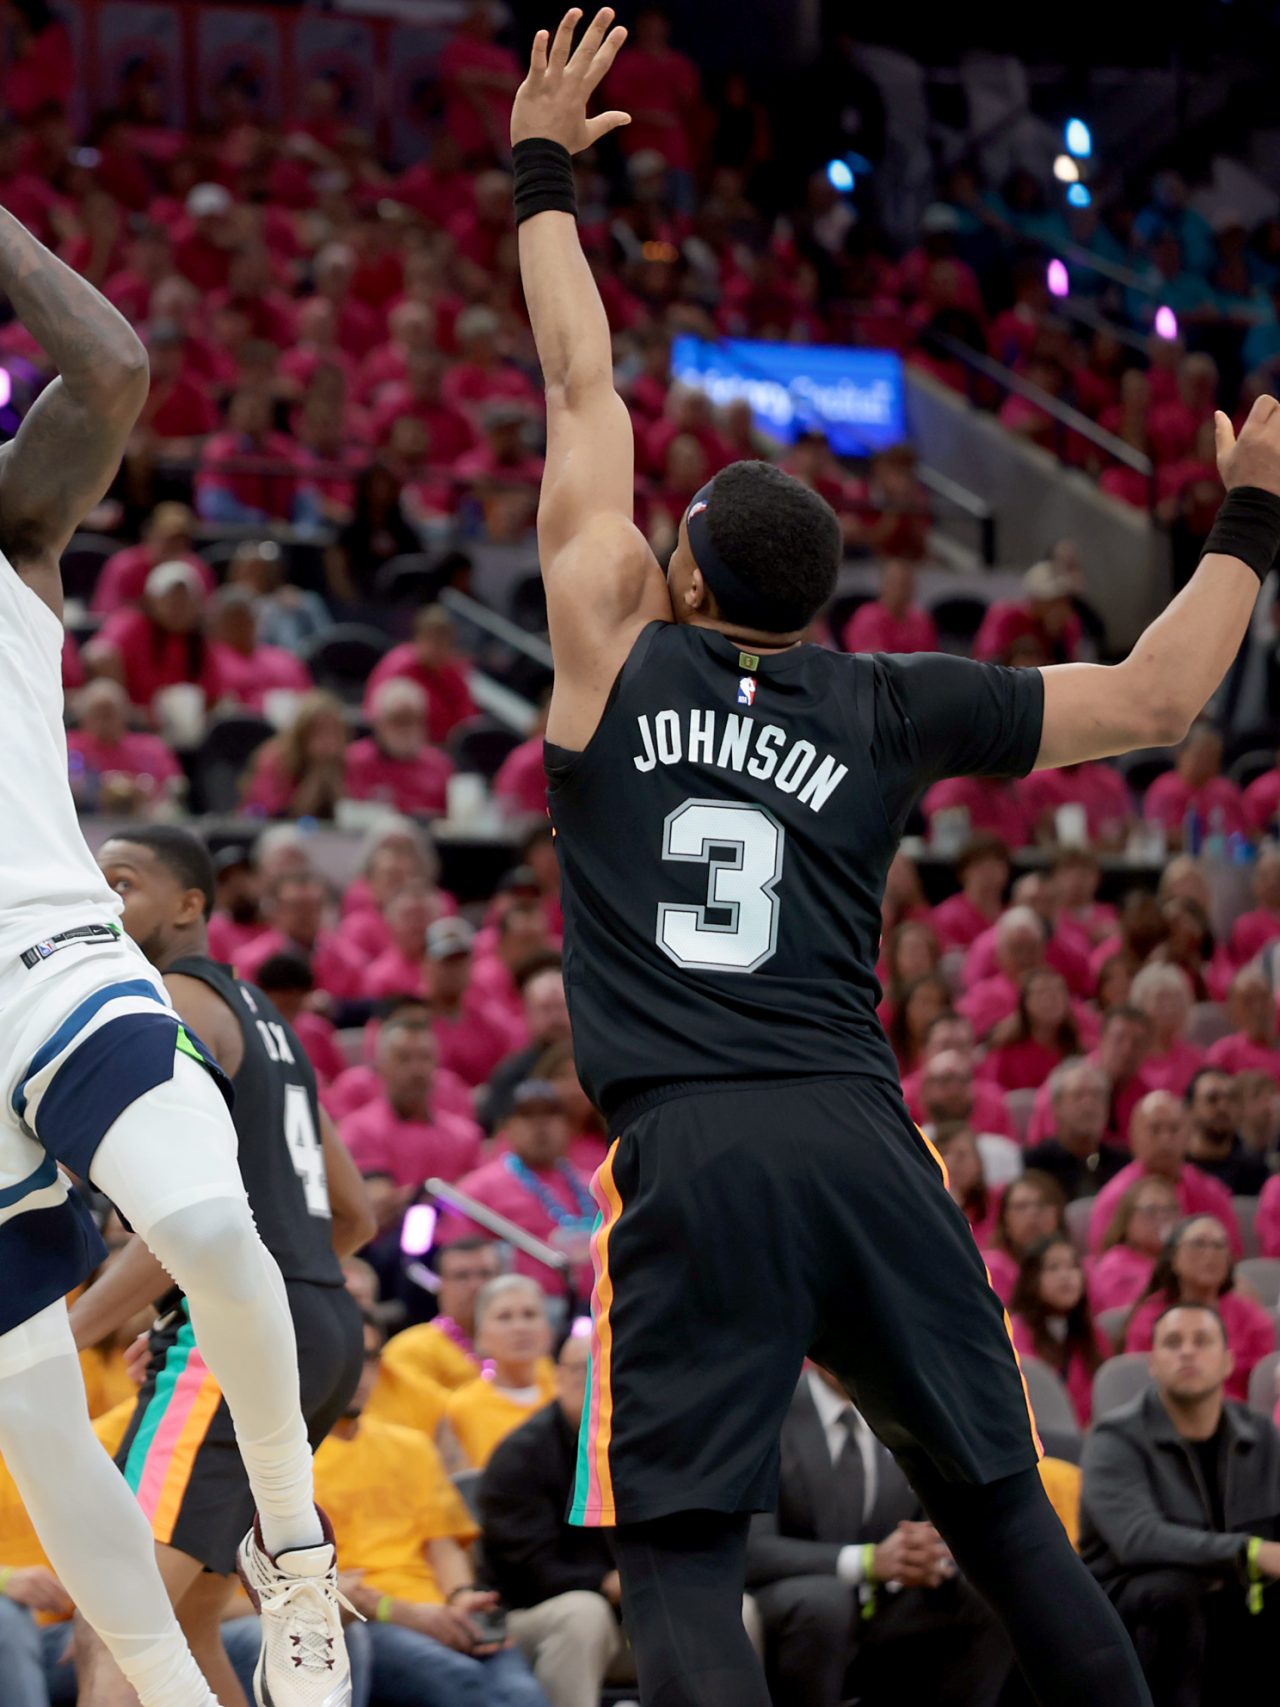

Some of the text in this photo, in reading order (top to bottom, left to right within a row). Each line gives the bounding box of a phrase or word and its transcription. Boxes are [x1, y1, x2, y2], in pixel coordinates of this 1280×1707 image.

[633, 708, 849, 813] JOHNSON
[655, 797, 785, 974] 3
[284, 1083, 332, 1219] 4
